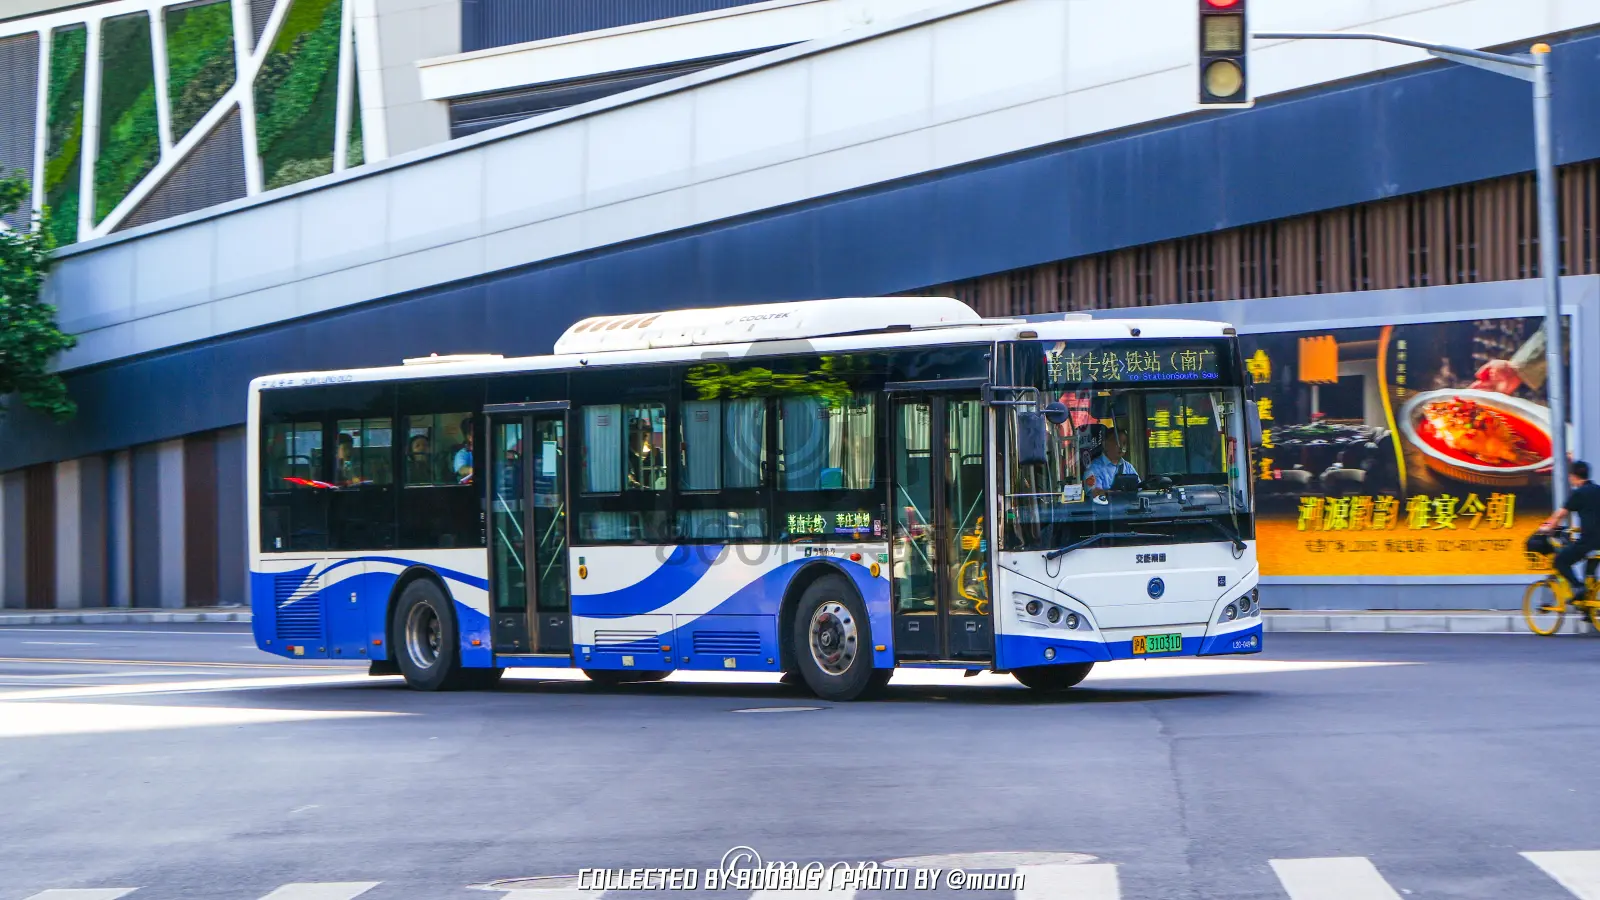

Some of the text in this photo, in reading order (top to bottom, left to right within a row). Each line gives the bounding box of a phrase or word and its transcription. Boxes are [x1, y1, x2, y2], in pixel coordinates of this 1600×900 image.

[739, 312, 791, 323] COOLTEK
[1047, 351, 1121, 383] 莘南专线
